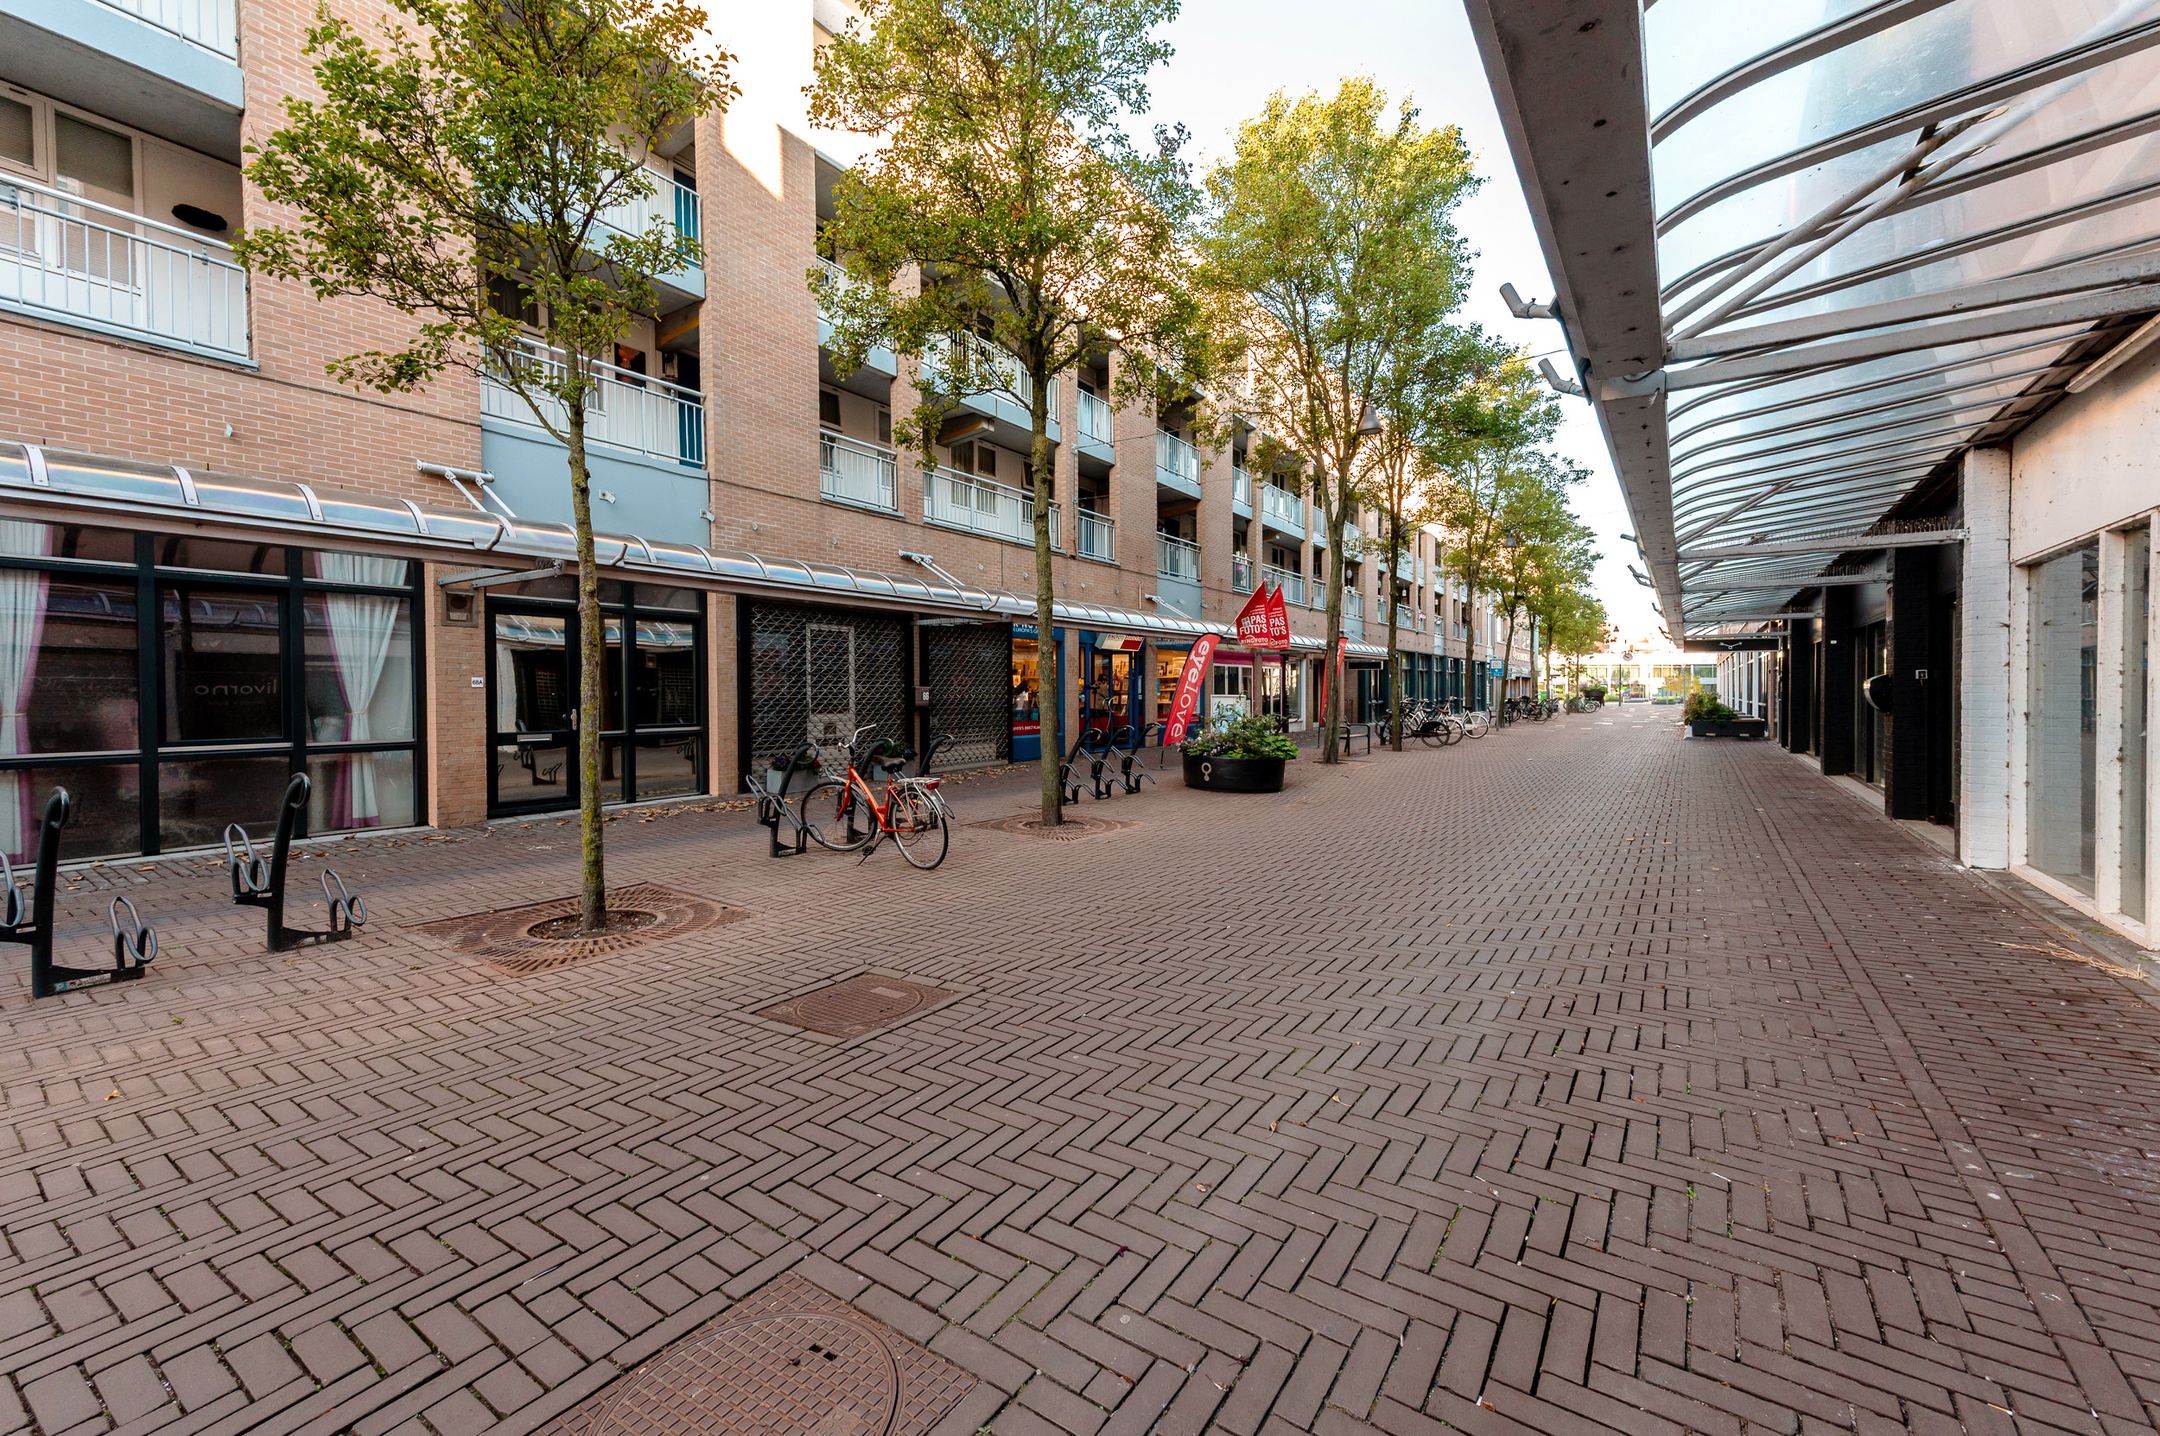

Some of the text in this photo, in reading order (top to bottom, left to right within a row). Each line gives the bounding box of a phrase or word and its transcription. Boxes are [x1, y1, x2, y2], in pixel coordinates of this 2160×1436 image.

[1251, 614, 1267, 625] PAS
[1269, 616, 1286, 627] PAS
[1239, 624, 1268, 635] FOTO'S
[1270, 626, 1287, 637] TO'S
[1171, 640, 1210, 738] eyelove
